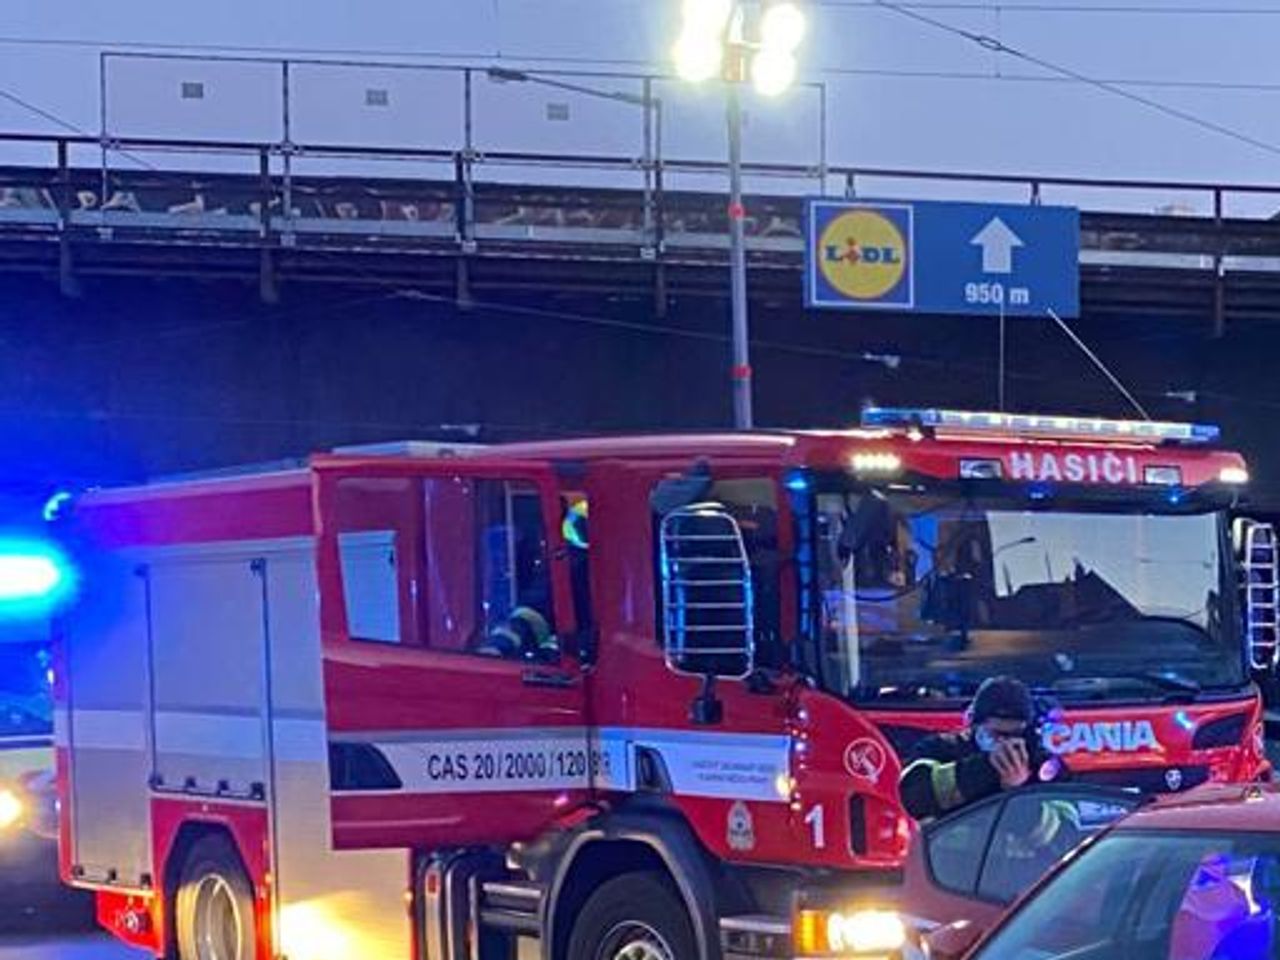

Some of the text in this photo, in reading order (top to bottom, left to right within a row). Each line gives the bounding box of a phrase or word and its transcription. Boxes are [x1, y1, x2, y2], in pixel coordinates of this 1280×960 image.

[965, 283, 1030, 305] 950 m
[1010, 451, 1136, 484] HASIČI
[1040, 720, 1160, 754] CANIA
[427, 754, 469, 780] CAS
[804, 804, 825, 849] 1
